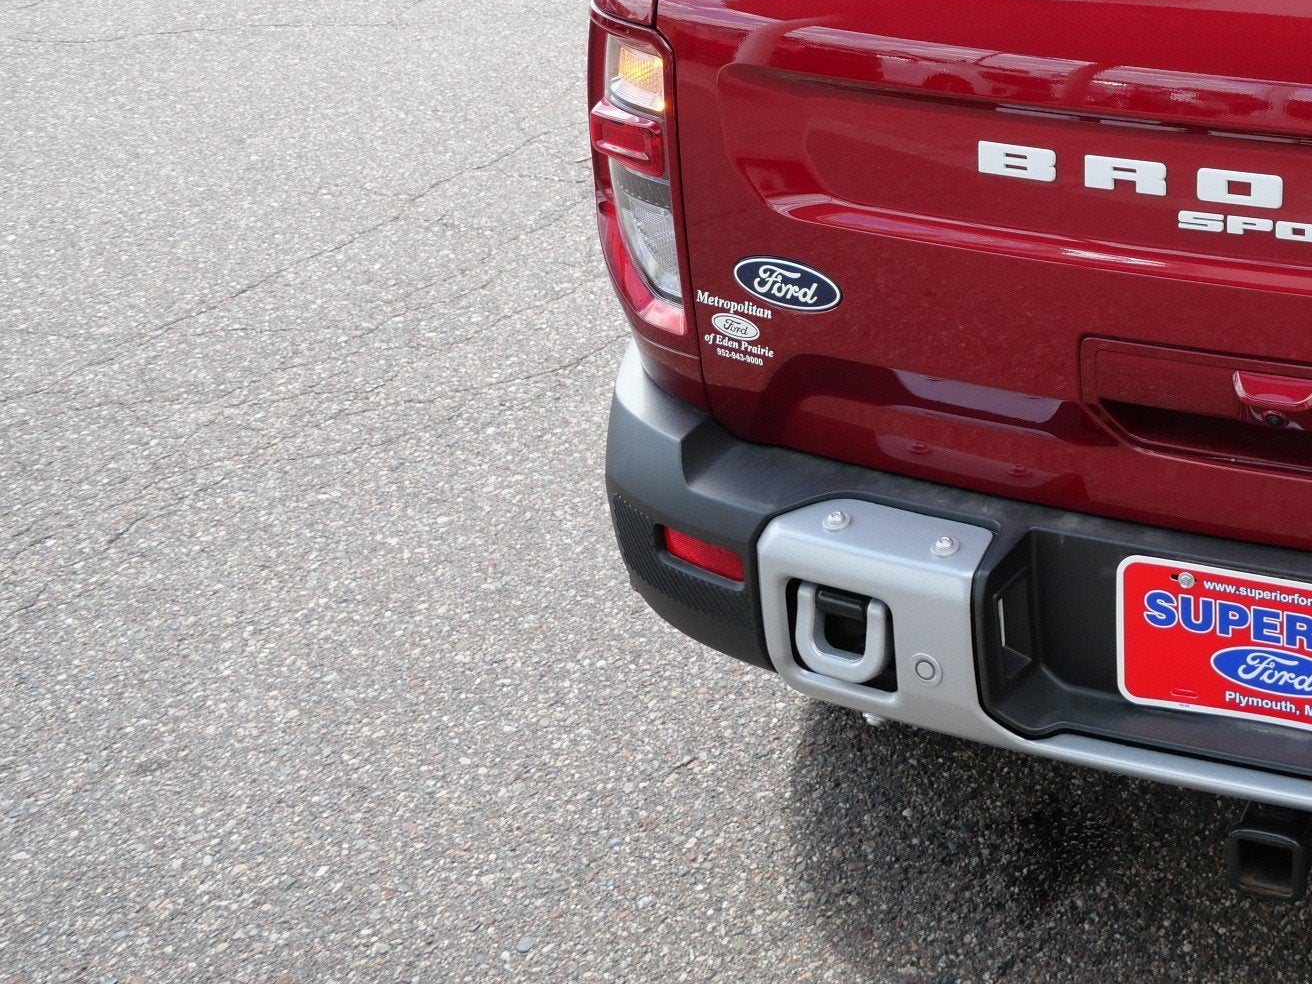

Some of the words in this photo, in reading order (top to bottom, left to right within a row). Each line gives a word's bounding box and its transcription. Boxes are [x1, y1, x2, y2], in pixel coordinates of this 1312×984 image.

[753, 264, 818, 304] Ford
[696, 289, 773, 320] Metropolitan
[722, 318, 749, 336] Ford
[704, 333, 715, 345] of
[715, 336, 739, 349] Eden
[740, 341, 774, 358] Prairie
[1225, 690, 1301, 716] Plymouth,
